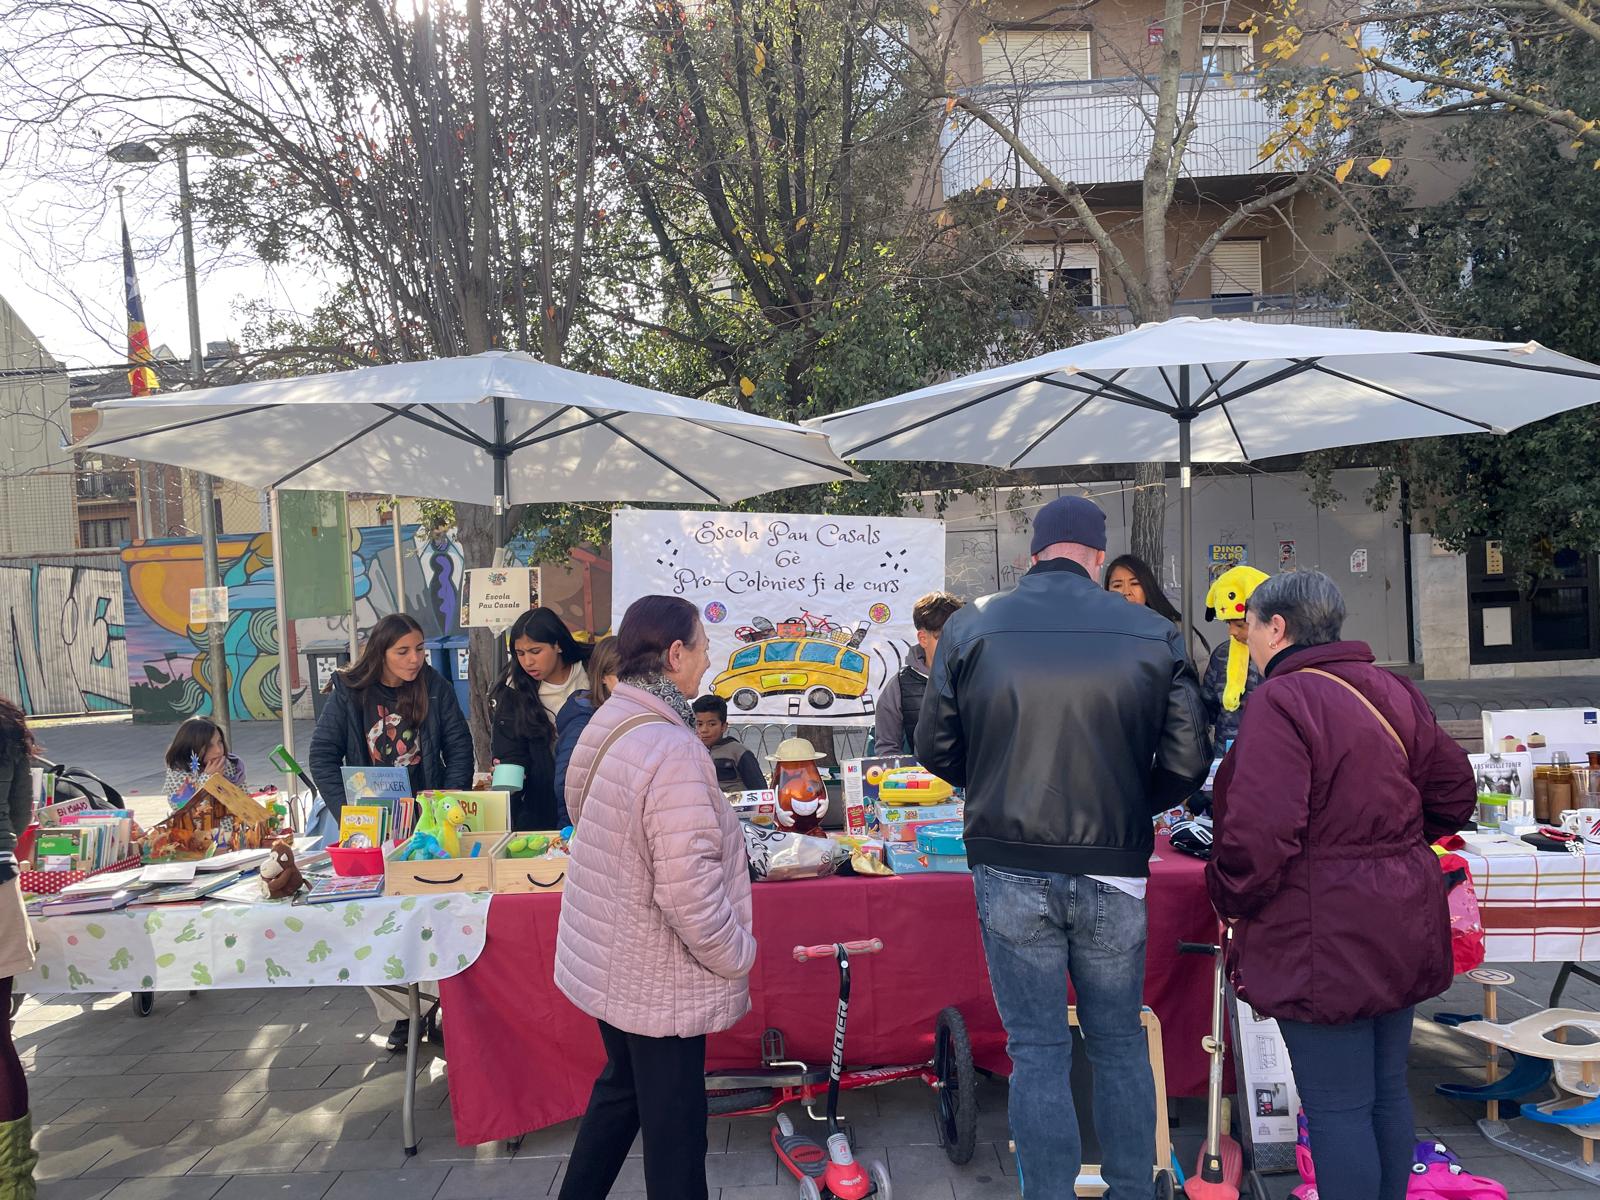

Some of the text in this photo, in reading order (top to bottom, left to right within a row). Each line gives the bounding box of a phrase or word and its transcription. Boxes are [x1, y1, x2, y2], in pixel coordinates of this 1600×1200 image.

[695, 521, 880, 547] Escola Pau Casals
[776, 550, 800, 567] 6è
[808, 572, 825, 597] fi
[834, 574, 855, 590] de
[864, 579, 899, 593] curs
